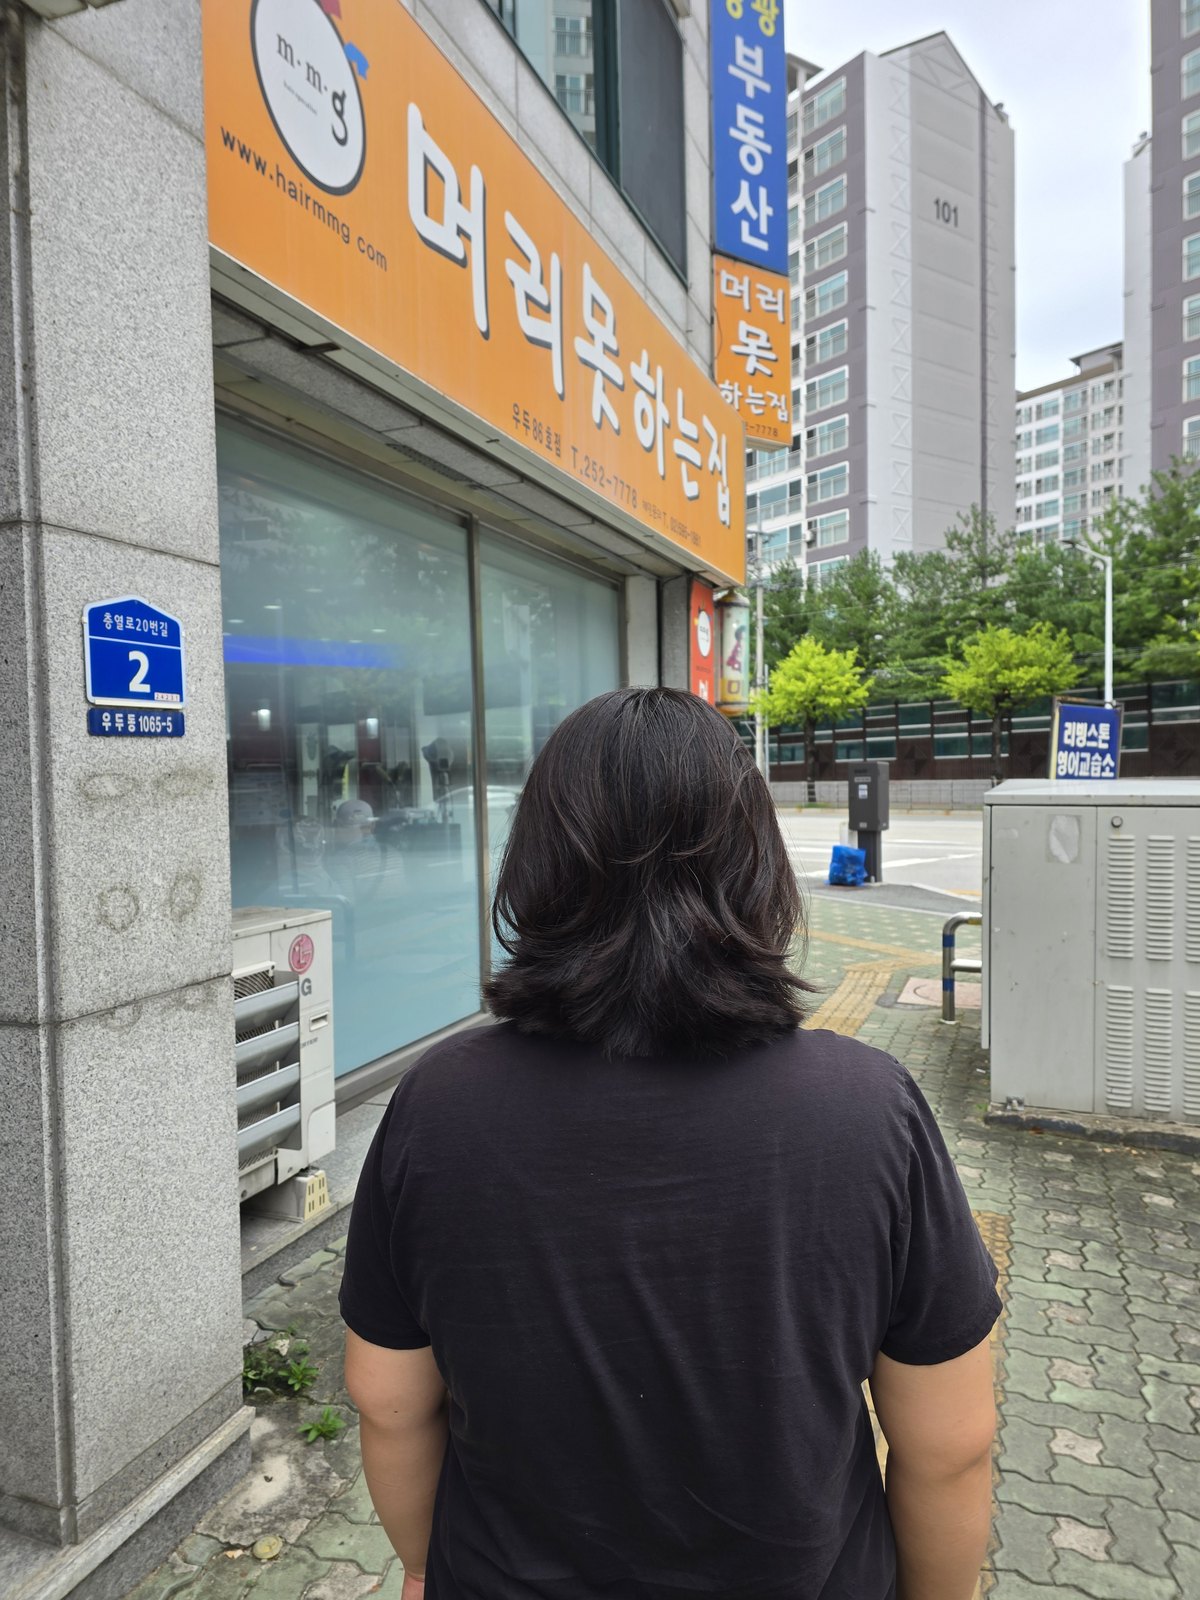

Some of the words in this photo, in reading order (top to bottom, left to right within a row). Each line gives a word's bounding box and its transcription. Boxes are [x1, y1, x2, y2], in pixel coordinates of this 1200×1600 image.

[728, 34, 774, 252] 부동산
[933, 197, 959, 228] 101
[719, 269, 786, 324] 머리
[730, 319, 779, 377] 못
[718, 379, 789, 424] 하는집
[103, 612, 169, 638] 충열로20번길
[128, 650, 151, 693] 2
[1063, 720, 1111, 750] 리빙스톤
[1057, 750, 1115, 778] 영어교습소
